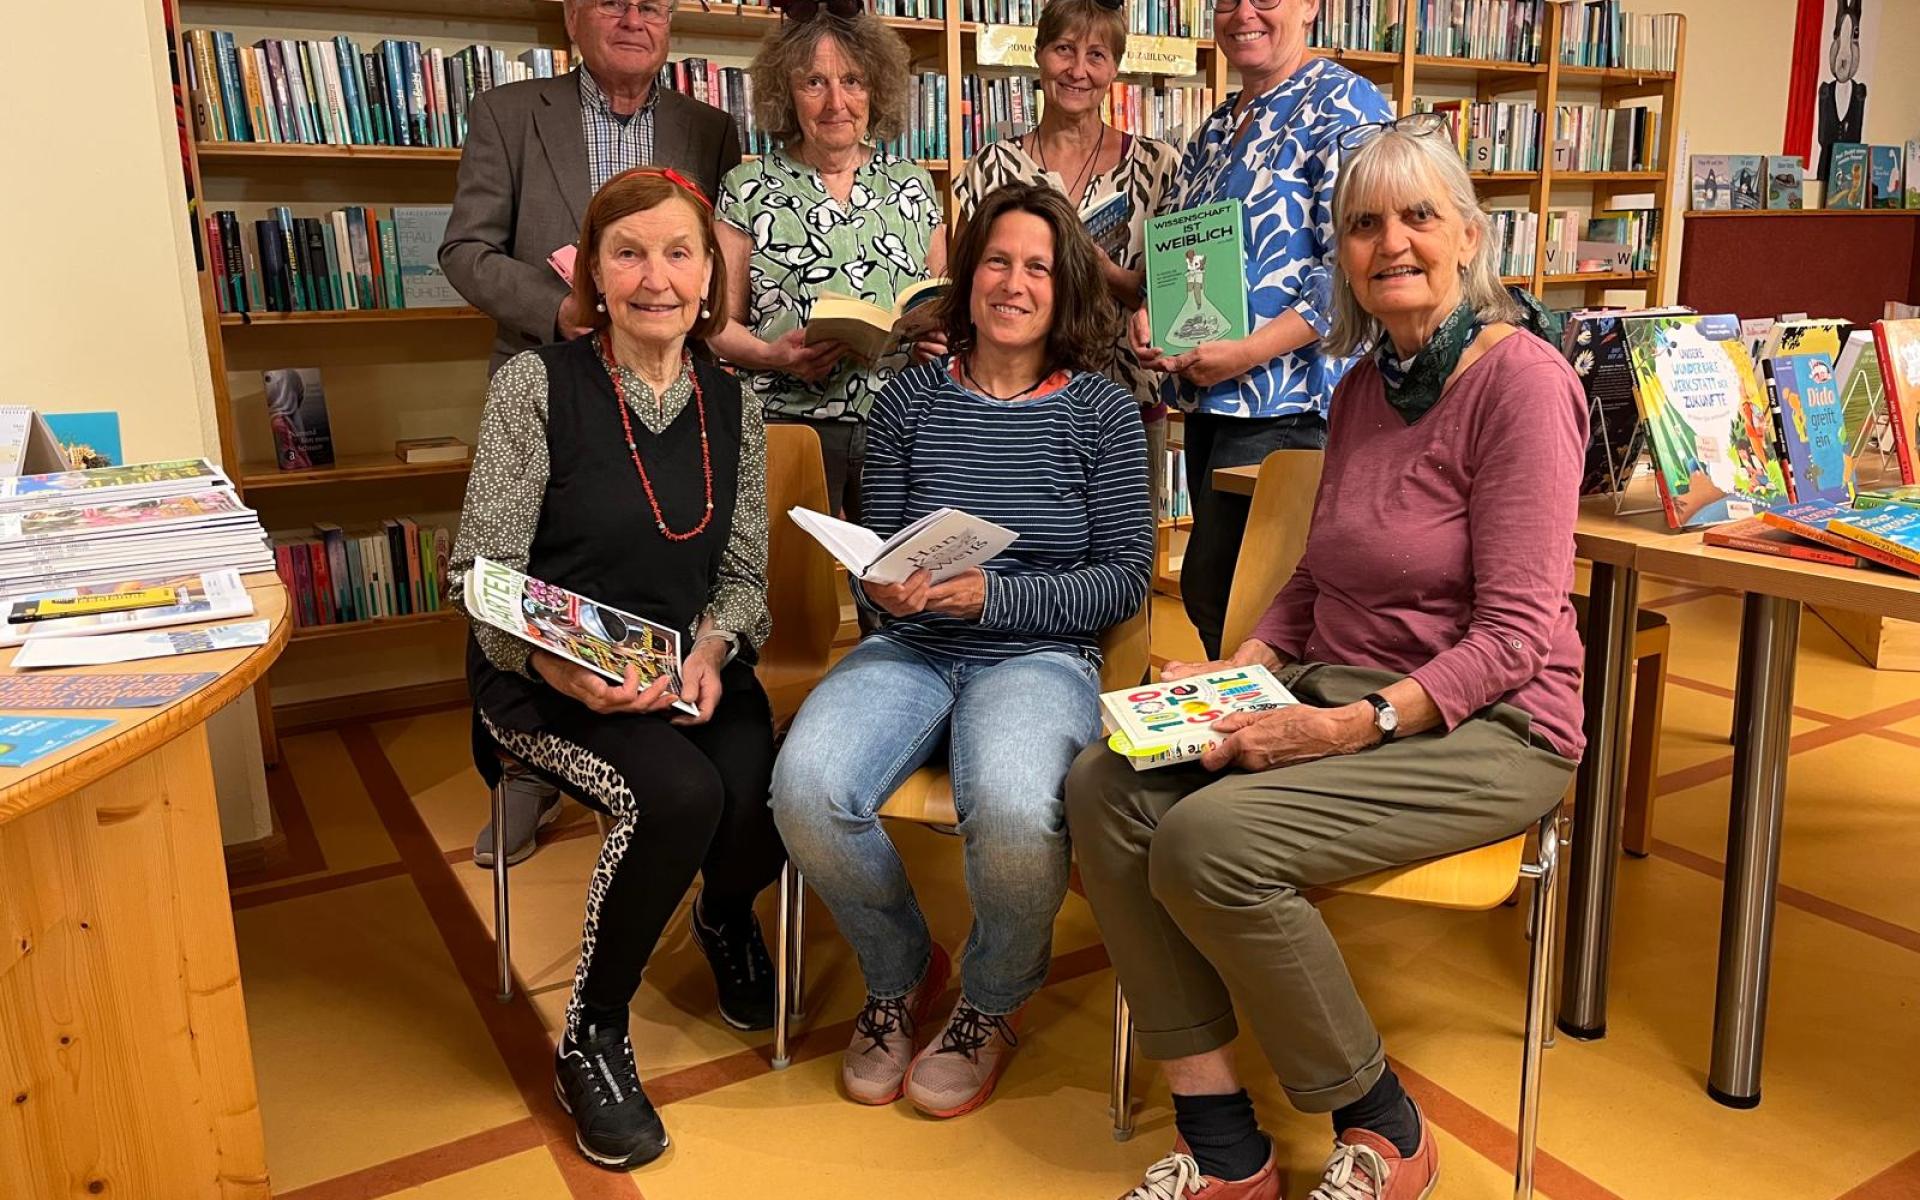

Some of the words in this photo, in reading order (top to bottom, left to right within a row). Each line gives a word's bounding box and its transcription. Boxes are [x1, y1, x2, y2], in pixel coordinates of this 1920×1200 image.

[1478, 147, 1488, 161] S
[1555, 148, 1565, 162] T
[1154, 205, 1232, 230] WISSENSCHAFT
[1184, 222, 1202, 234] IST
[1155, 225, 1233, 253] WEIBLICH
[1546, 249, 1556, 262] V
[1617, 252, 1631, 265] W
[1672, 377, 1715, 392] WERKSTATT
[1807, 387, 1835, 407] Dido
[1811, 408, 1838, 431] greift
[1815, 431, 1831, 448] ein
[907, 535, 957, 562] Han
